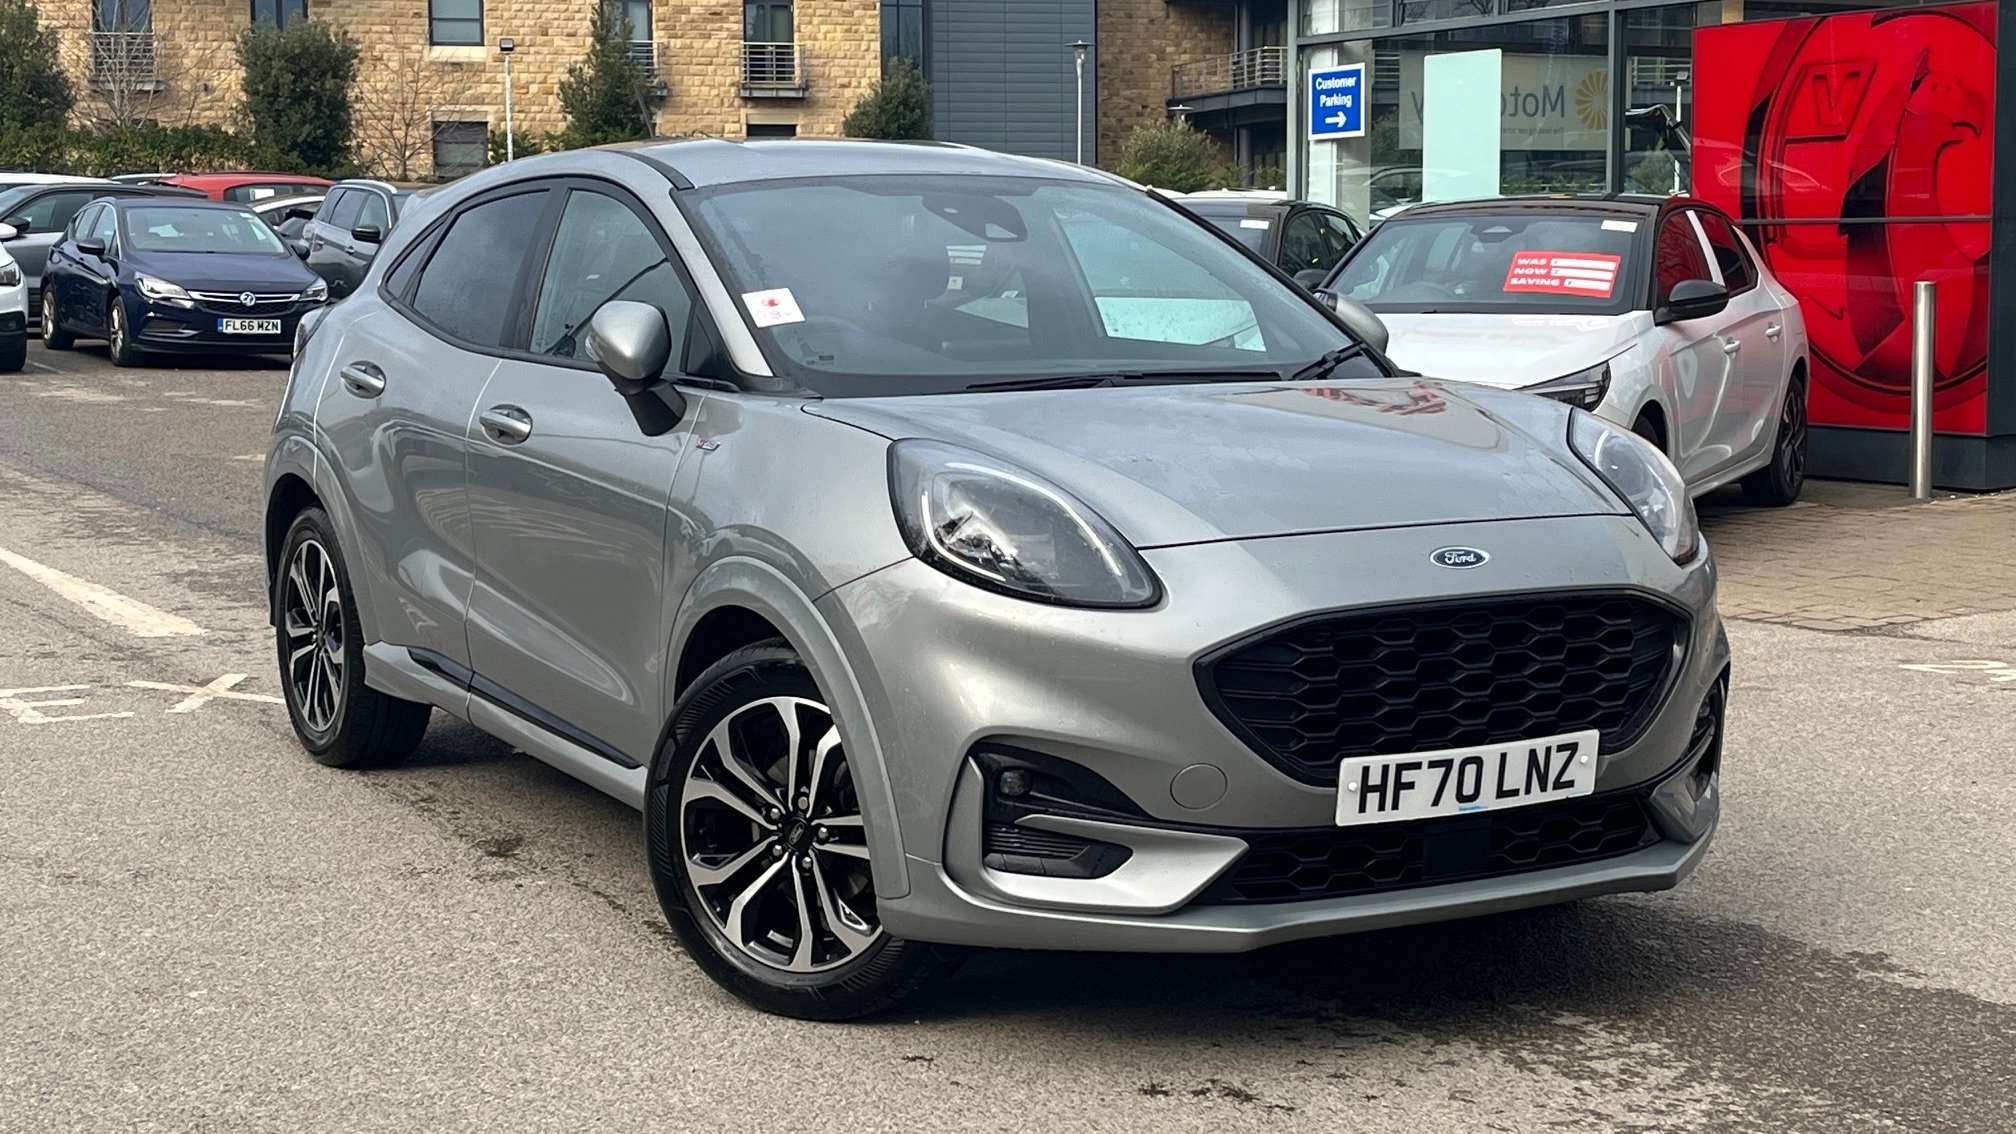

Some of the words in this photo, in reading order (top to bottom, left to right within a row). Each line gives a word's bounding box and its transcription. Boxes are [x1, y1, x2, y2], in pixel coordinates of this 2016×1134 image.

[1315, 76, 1357, 90] Customer
[1319, 93, 1353, 108] Parking
[1517, 258, 1547, 266] WAS
[1514, 267, 1549, 275] NOW
[1510, 277, 1561, 287] SAVING
[224, 320, 255, 332] FL66
[256, 320, 280, 332] MZN
[1444, 550, 1477, 564] Ford
[1358, 756, 1484, 814] HF70
[1495, 741, 1580, 801] LNZ
